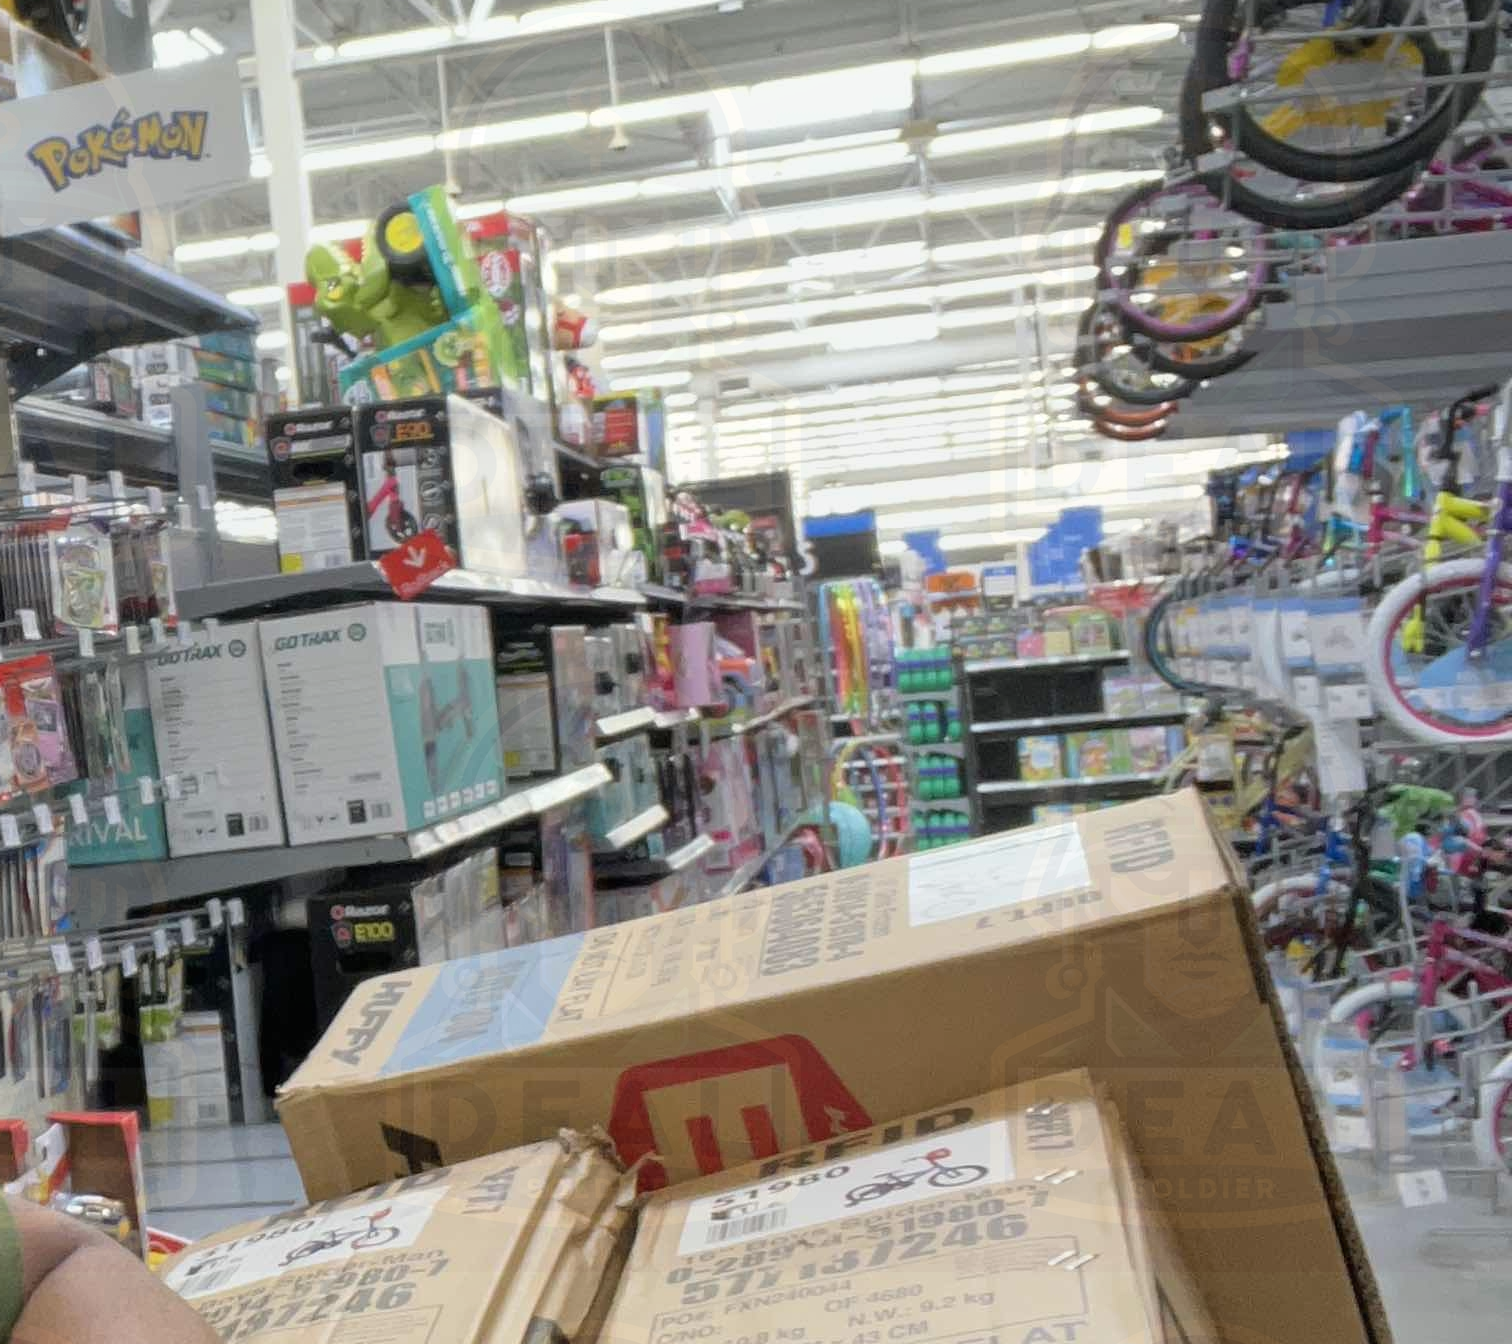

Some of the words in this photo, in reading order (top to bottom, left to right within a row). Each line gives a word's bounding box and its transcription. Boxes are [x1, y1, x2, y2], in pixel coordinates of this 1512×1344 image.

[274, 628, 342, 653] GOTRAX
[1103, 817, 1176, 873] RFID
[331, 979, 413, 1066] HUFFY
[713, 1165, 851, 1207] 51980
[865, 1284, 924, 1303] 4680
[776, 1327, 806, 1342] kg
[920, 1295, 957, 1313] 9.2
[963, 1292, 995, 1306] kg
[889, 1319, 929, 1339] CM
